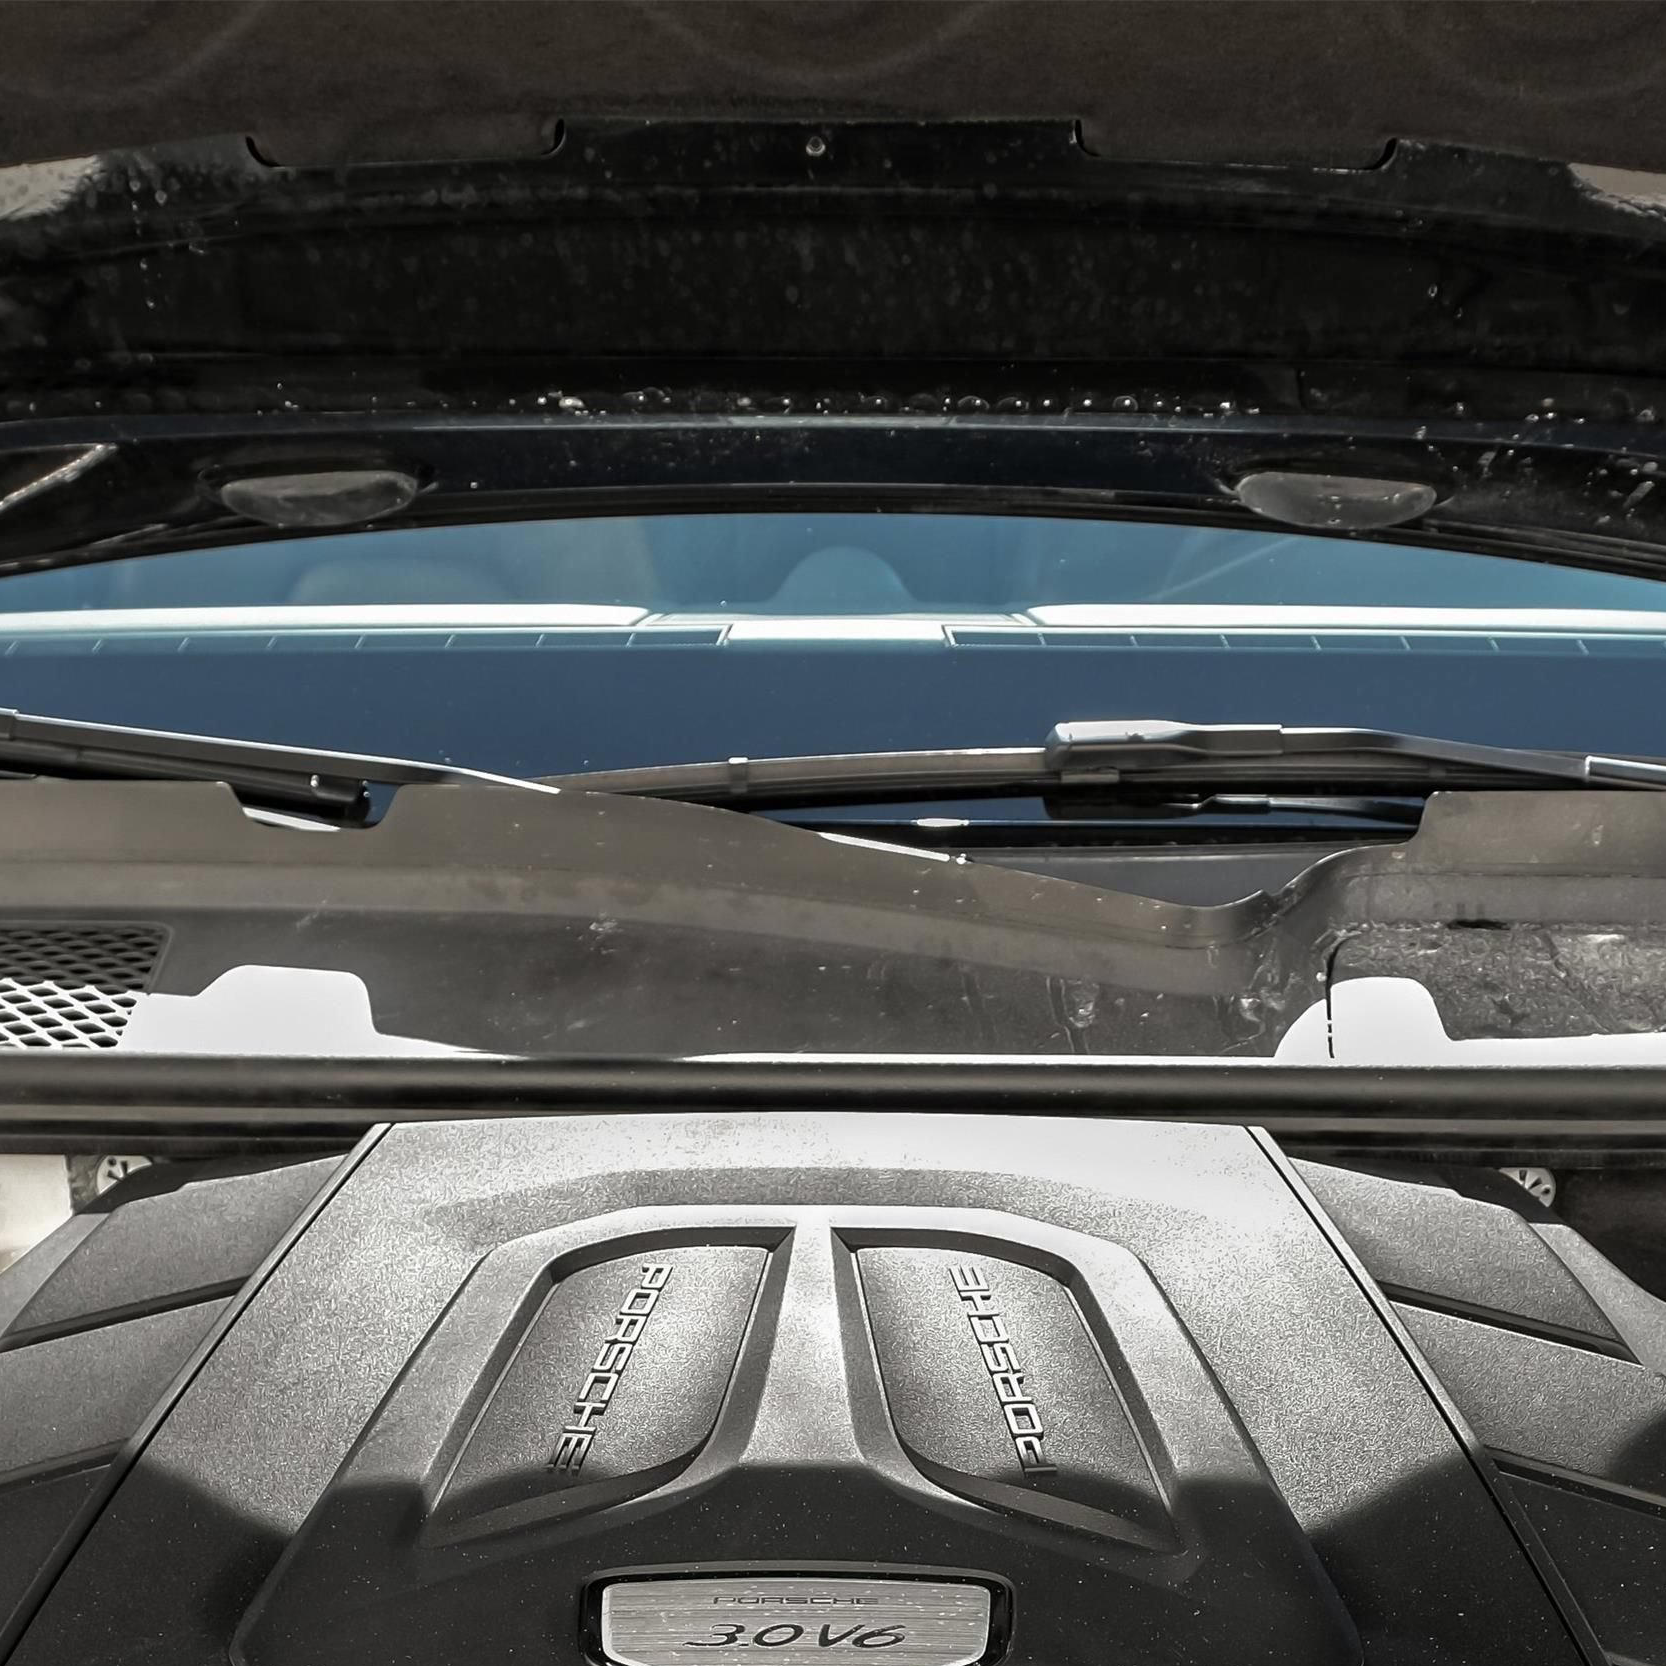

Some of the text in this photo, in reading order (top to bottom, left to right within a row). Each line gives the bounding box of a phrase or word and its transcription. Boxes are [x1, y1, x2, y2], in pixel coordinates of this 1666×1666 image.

[544, 1263, 673, 1476] PORSCHE
[948, 1264, 1057, 1474] PORSCHE
[682, 1623, 907, 1648] 3.0 V6
[713, 1595, 879, 1605] PORSCHE
